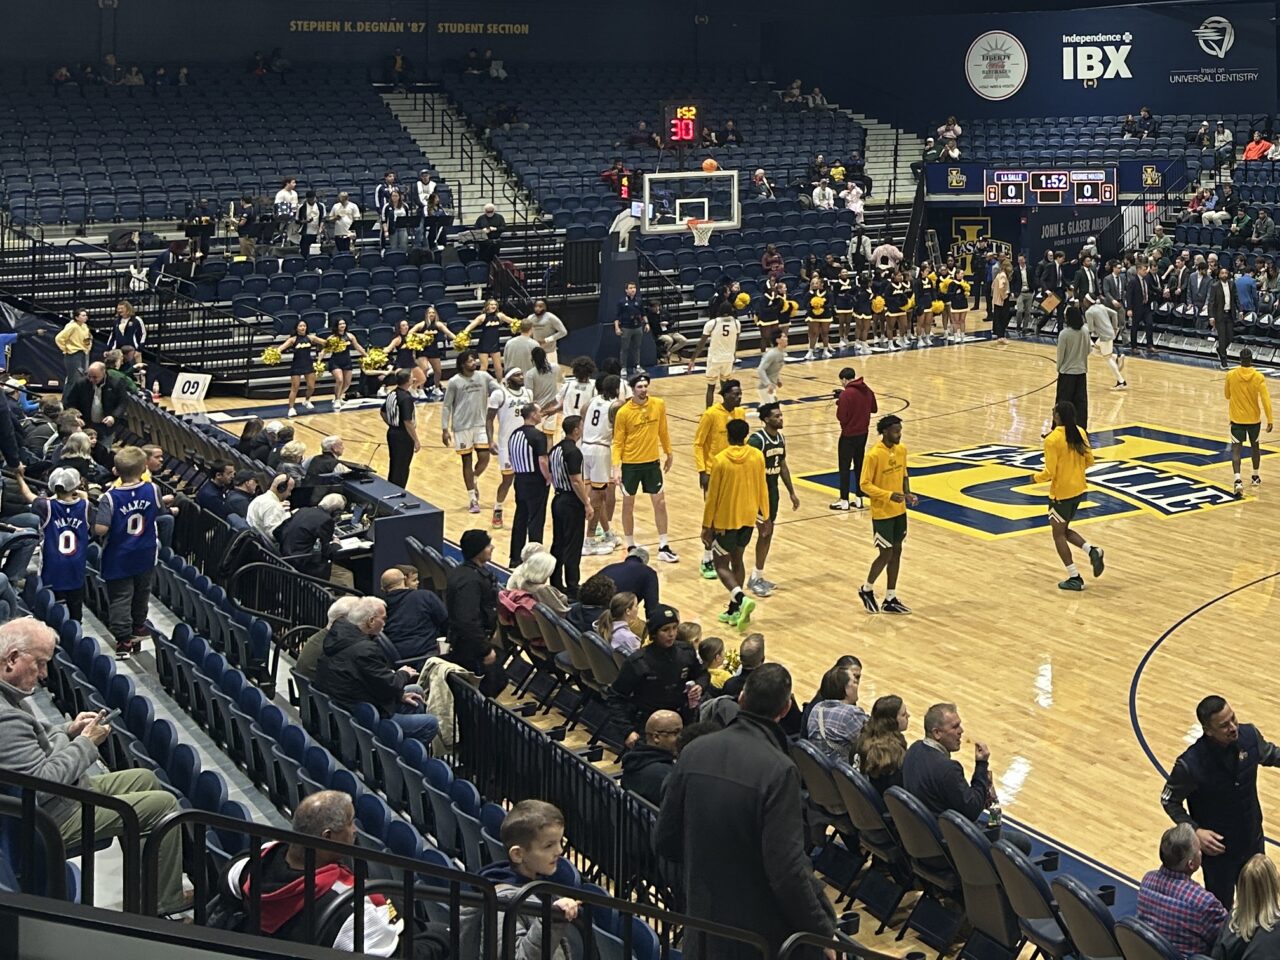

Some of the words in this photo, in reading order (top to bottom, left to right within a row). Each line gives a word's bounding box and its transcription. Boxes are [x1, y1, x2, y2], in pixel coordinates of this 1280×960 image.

[290, 21, 340, 33] STEPHEN
[357, 22, 403, 33] DEGNAN
[407, 23, 426, 33] '87
[438, 23, 484, 34] STUDENT
[487, 24, 529, 34] SECTION
[1063, 33, 1121, 43] Independence
[1063, 45, 1133, 80] IBX
[1169, 74, 1213, 84] UNIVERSAL
[1215, 72, 1259, 83] DENTISTRY
[670, 119, 694, 140] 30
[1001, 174, 1008, 182] LA
[1008, 173, 1023, 182] SALLE
[1040, 175, 1067, 189] 1:52
[1008, 185, 1016, 197] 0
[1084, 185, 1092, 197] 0
[1041, 223, 1059, 239] JOHN
[1060, 222, 1066, 236] E.
[1067, 219, 1090, 235] GLASER
[722, 324, 730, 337] 5
[573, 393, 580, 409] 1
[591, 409, 600, 426] 8
[120, 500, 151, 515] MAXEY
[54, 518, 82, 529] MAXEY
[127, 513, 144, 535] 0
[59, 530, 76, 554] 0
